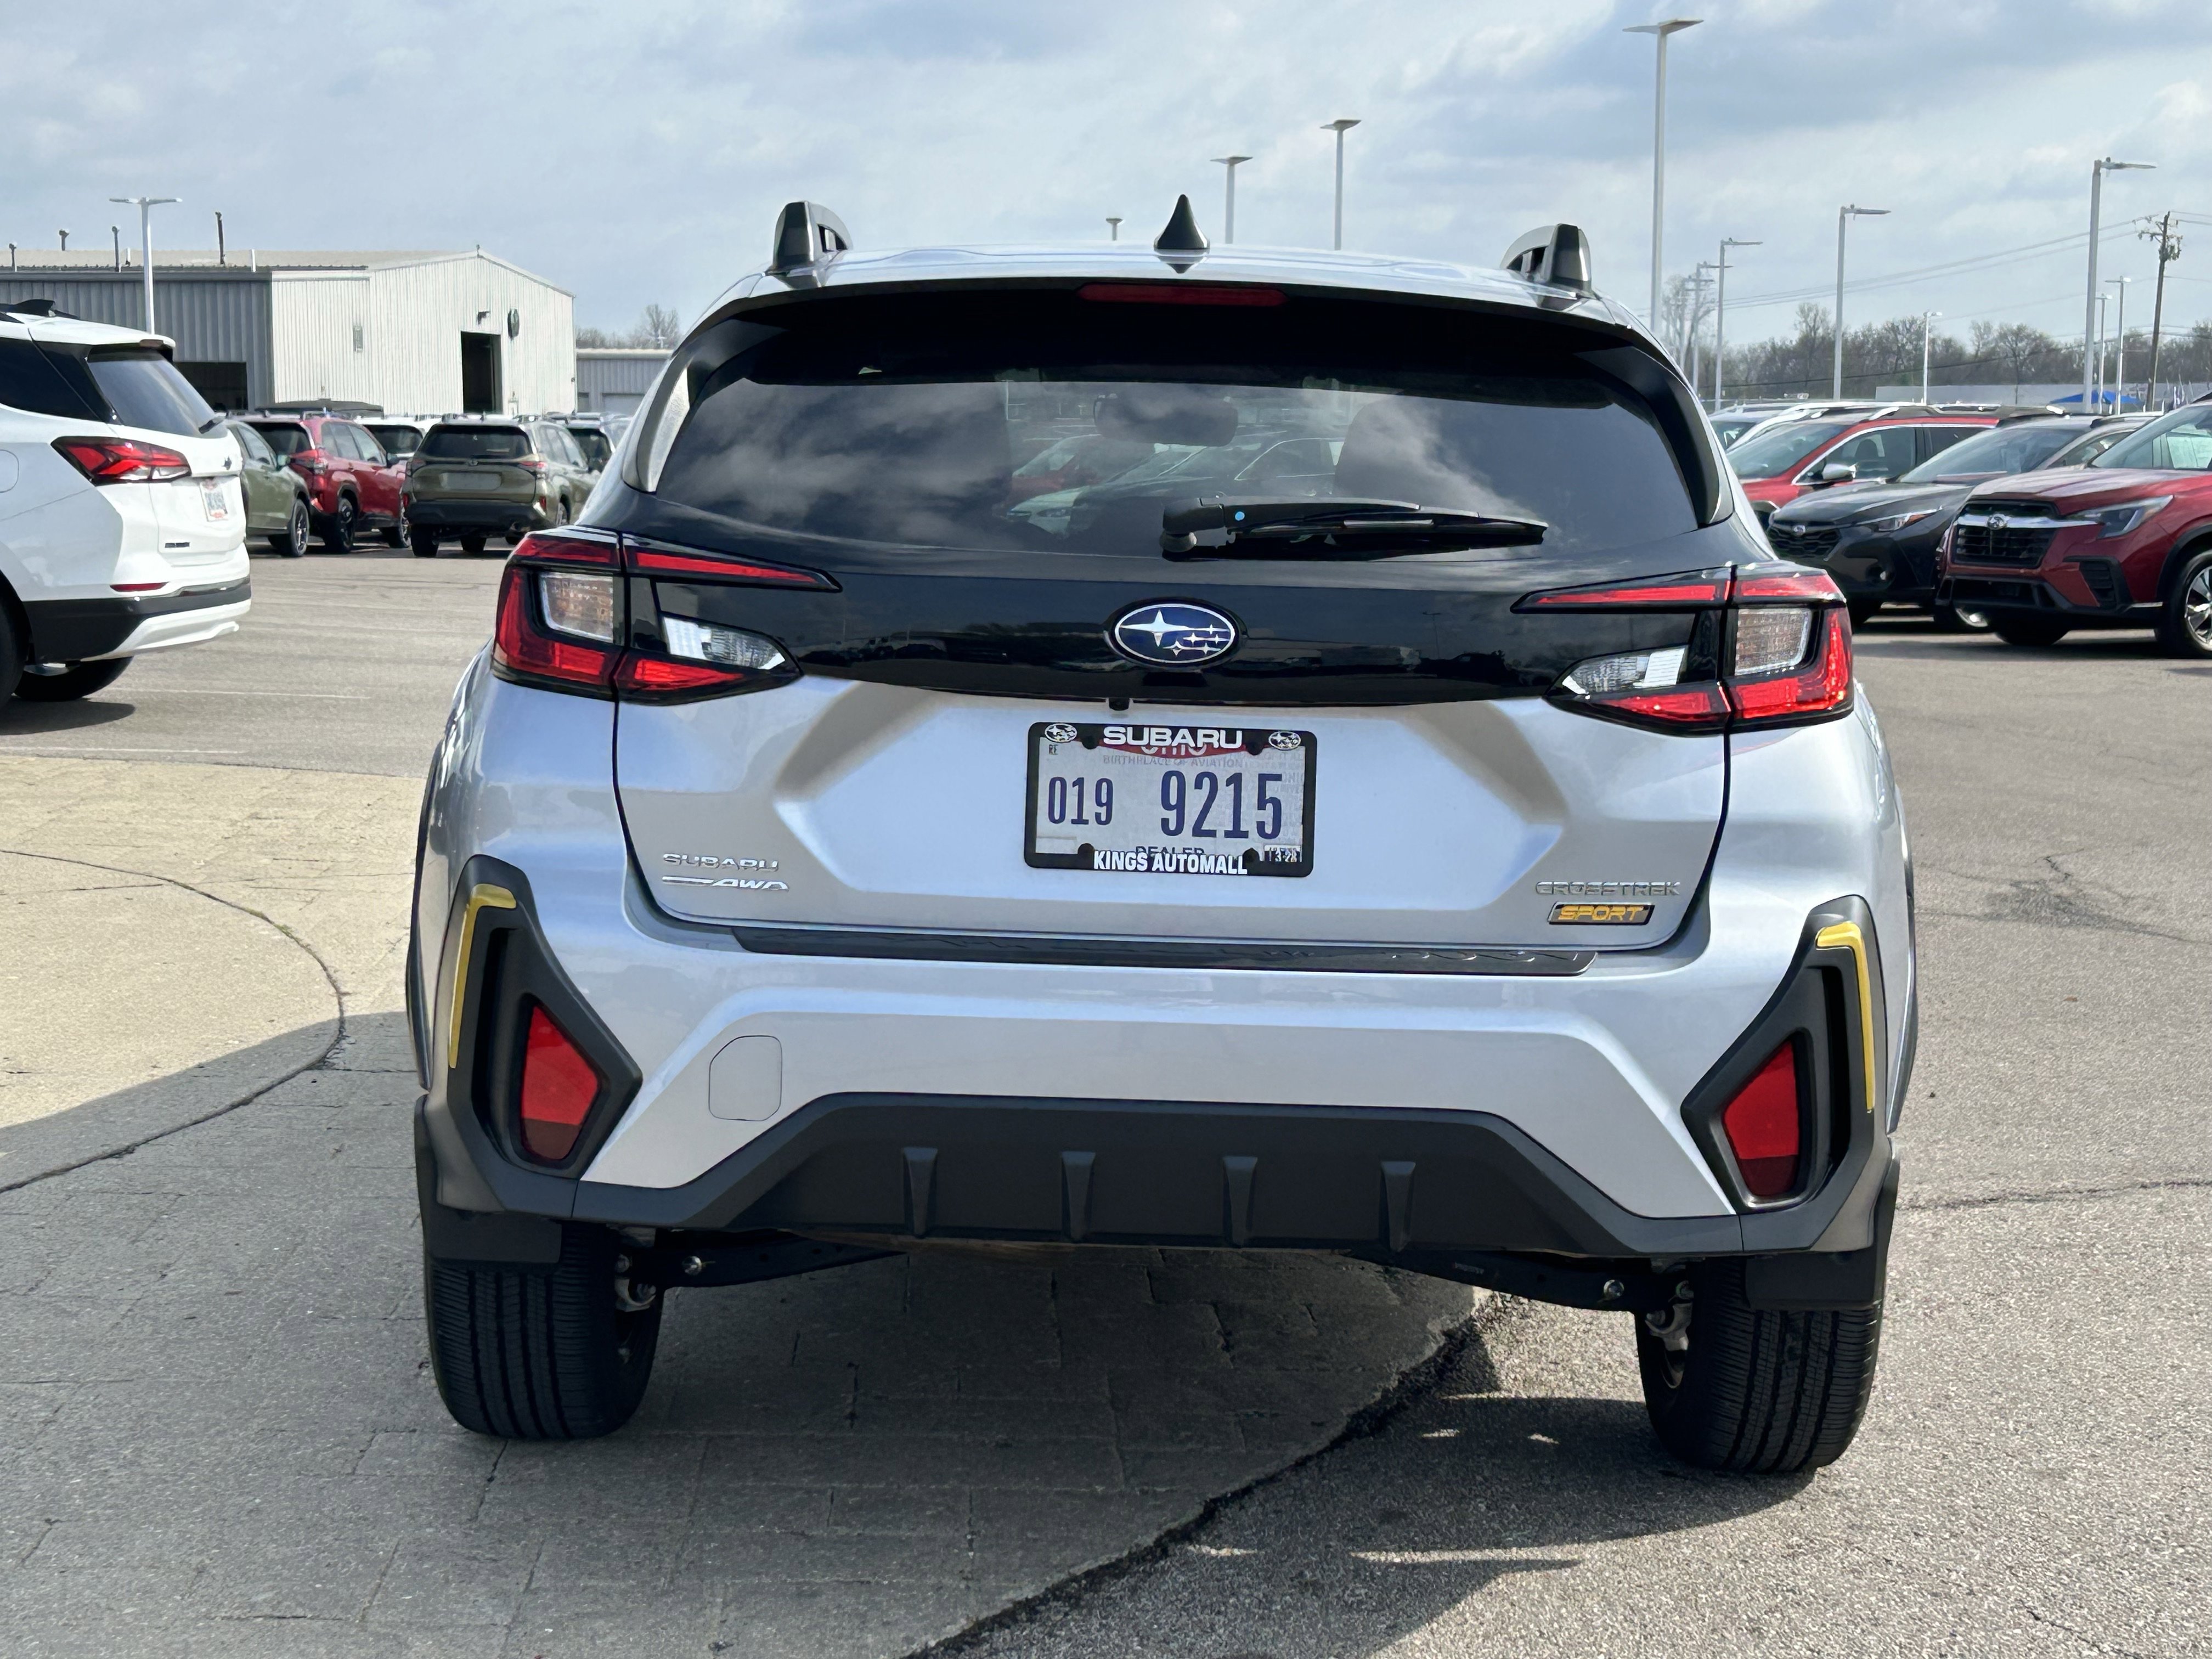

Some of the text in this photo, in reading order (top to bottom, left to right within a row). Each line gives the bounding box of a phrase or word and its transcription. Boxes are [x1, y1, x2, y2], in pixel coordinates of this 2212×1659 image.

[1103, 726, 1243, 749] SUBARU
[1190, 757, 1244, 768] AVIATION
[1047, 770, 1283, 839] 019 9215
[662, 853, 779, 872] SUBARU
[1093, 850, 1148, 871] KINGS
[1152, 853, 1248, 875] AUTOMALL
[712, 878, 789, 891] AWD
[1536, 881, 1681, 896] CROSSTREK
[1558, 905, 1644, 922] SPORT
